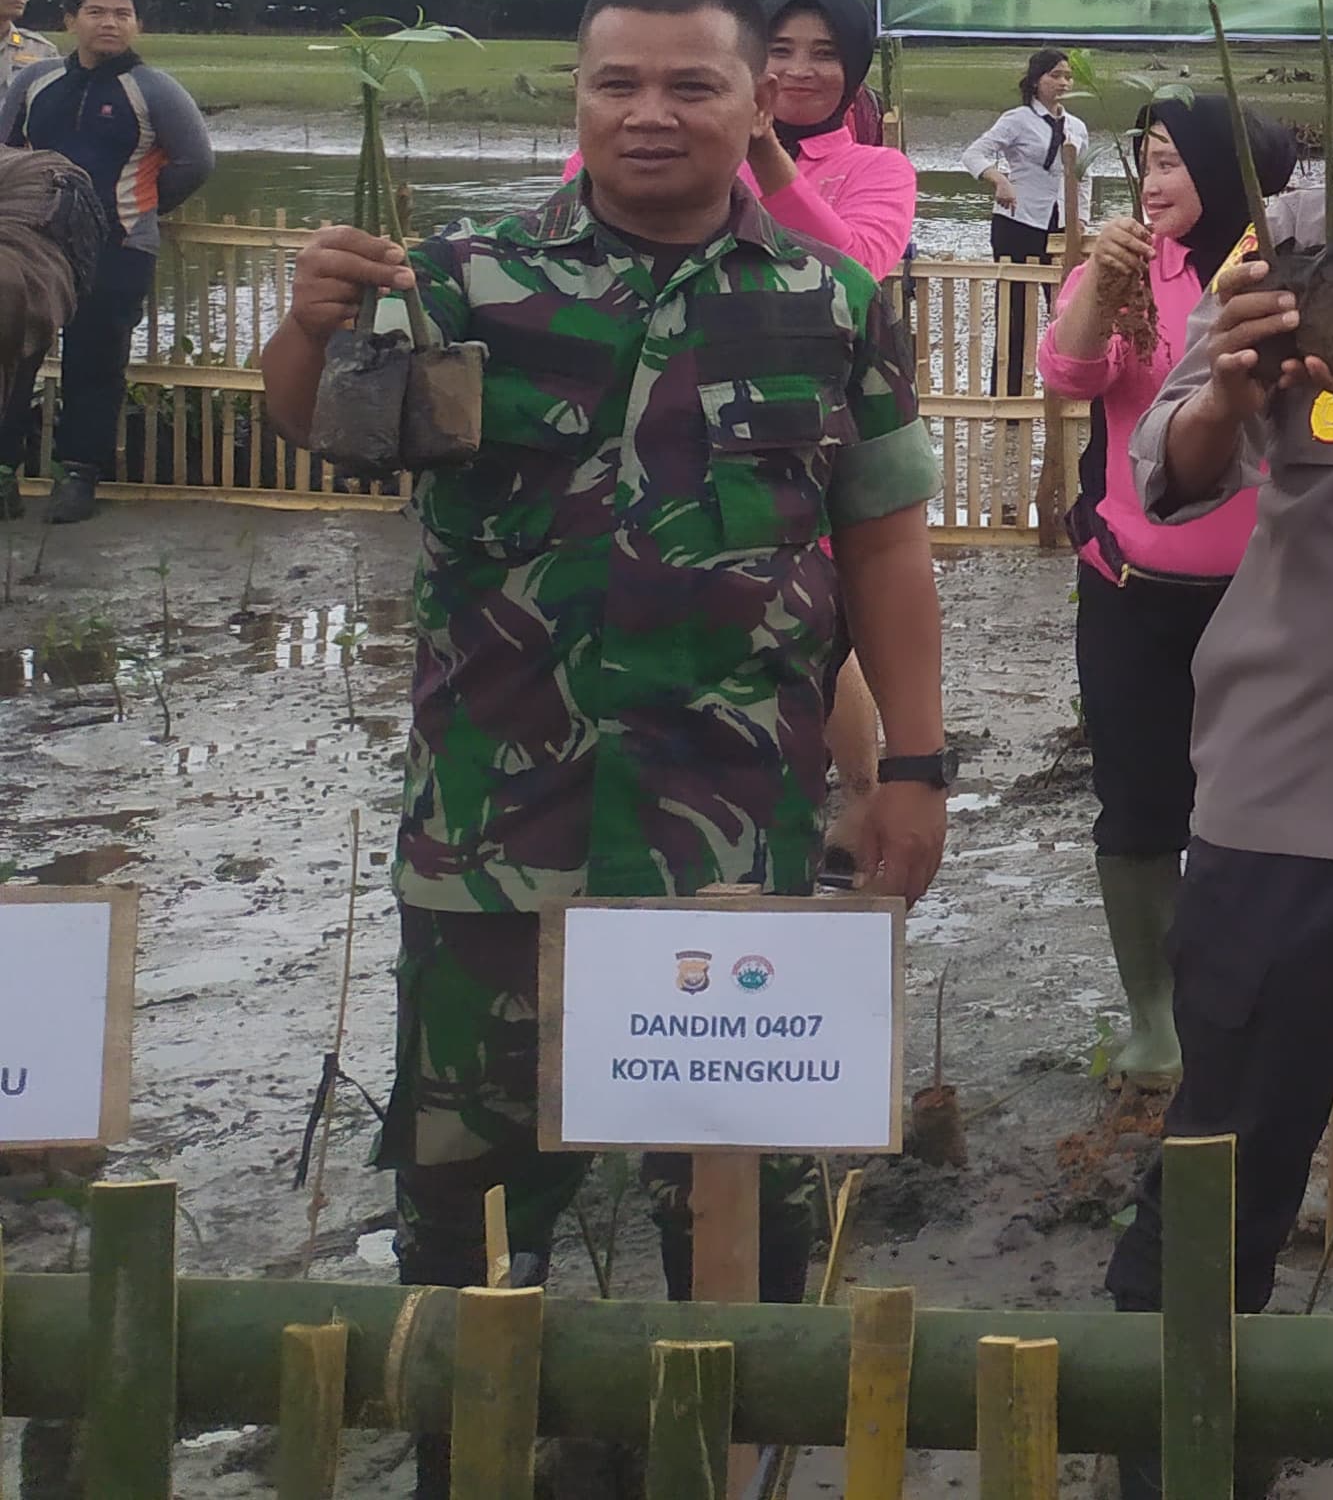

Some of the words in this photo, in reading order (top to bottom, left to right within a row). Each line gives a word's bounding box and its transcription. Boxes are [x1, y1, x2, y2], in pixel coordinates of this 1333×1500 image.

[629, 1013, 747, 1038] DANDIM
[755, 1014, 824, 1038] 0407
[611, 1057, 681, 1082] KOTA
[689, 1059, 841, 1083] BENGKULU
